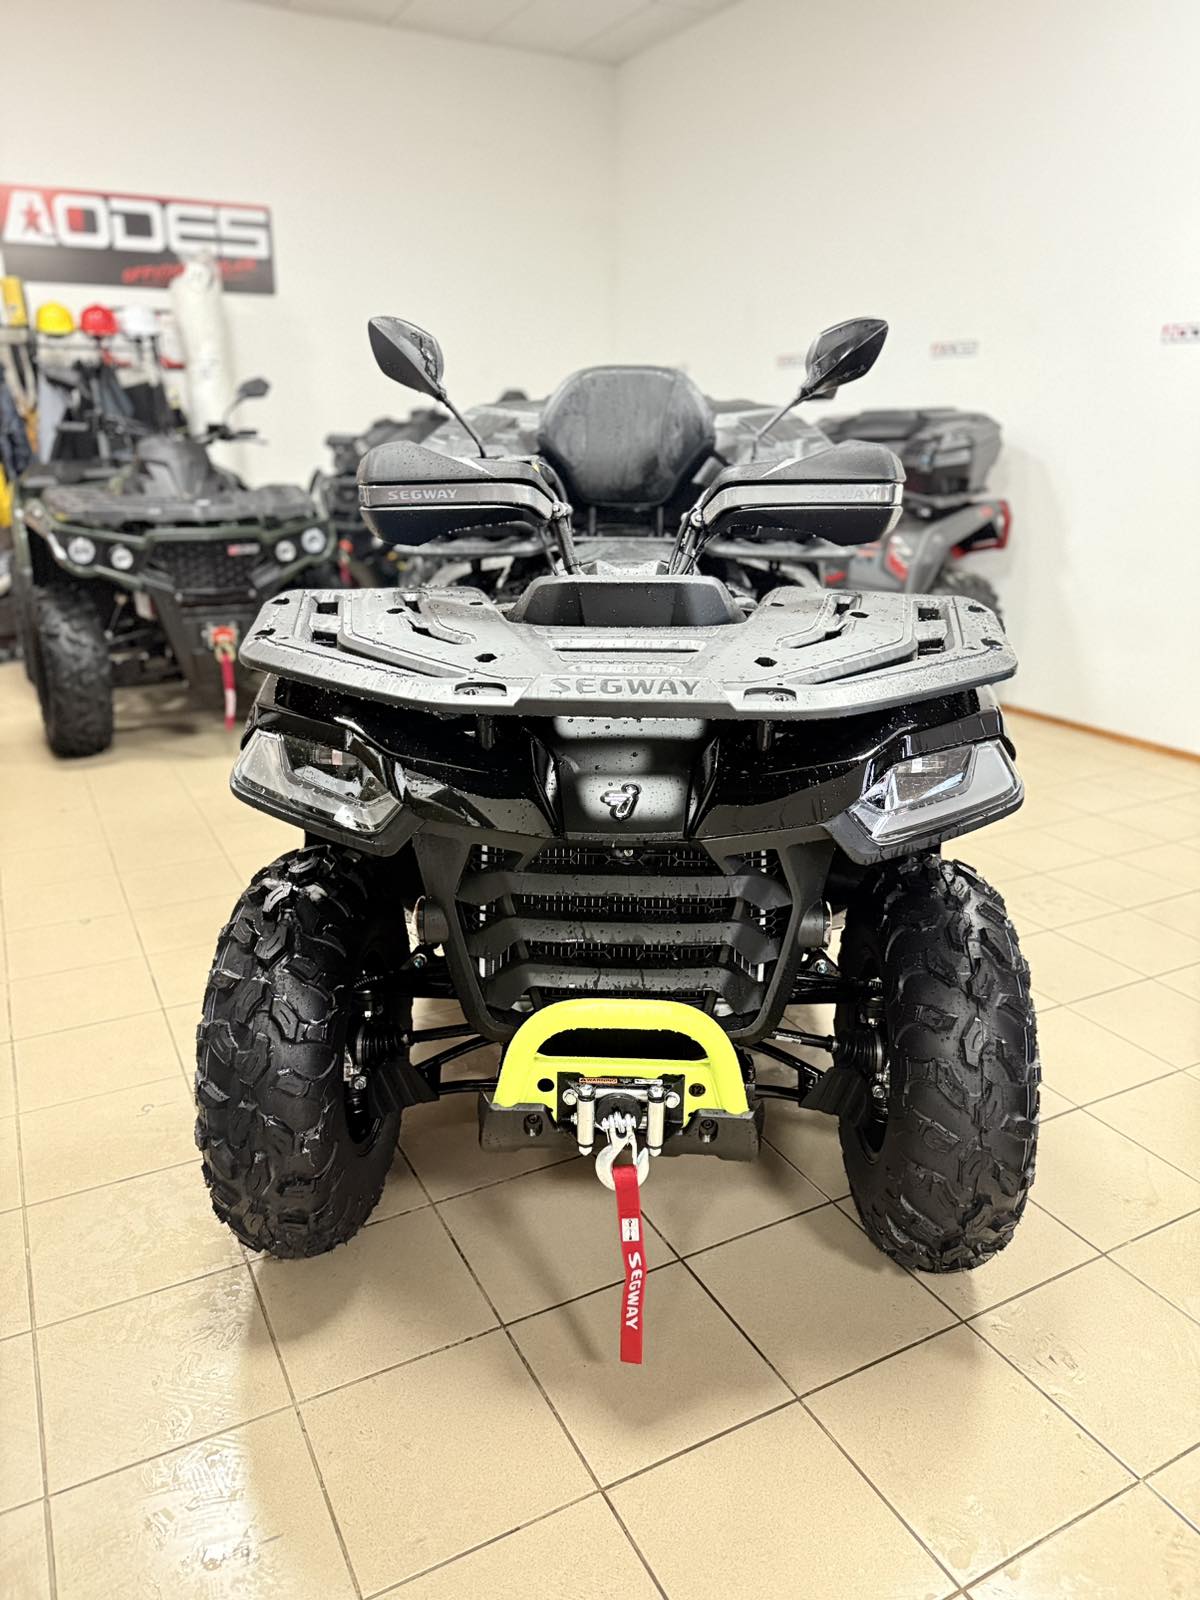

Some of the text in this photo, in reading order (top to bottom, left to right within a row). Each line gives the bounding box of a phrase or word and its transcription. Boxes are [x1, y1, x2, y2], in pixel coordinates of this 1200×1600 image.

[3, 189, 270, 260] AODES
[387, 488, 458, 500] SEGWAY
[549, 677, 700, 696] SEGWAY
[625, 1251, 643, 1330] SEGWAY
